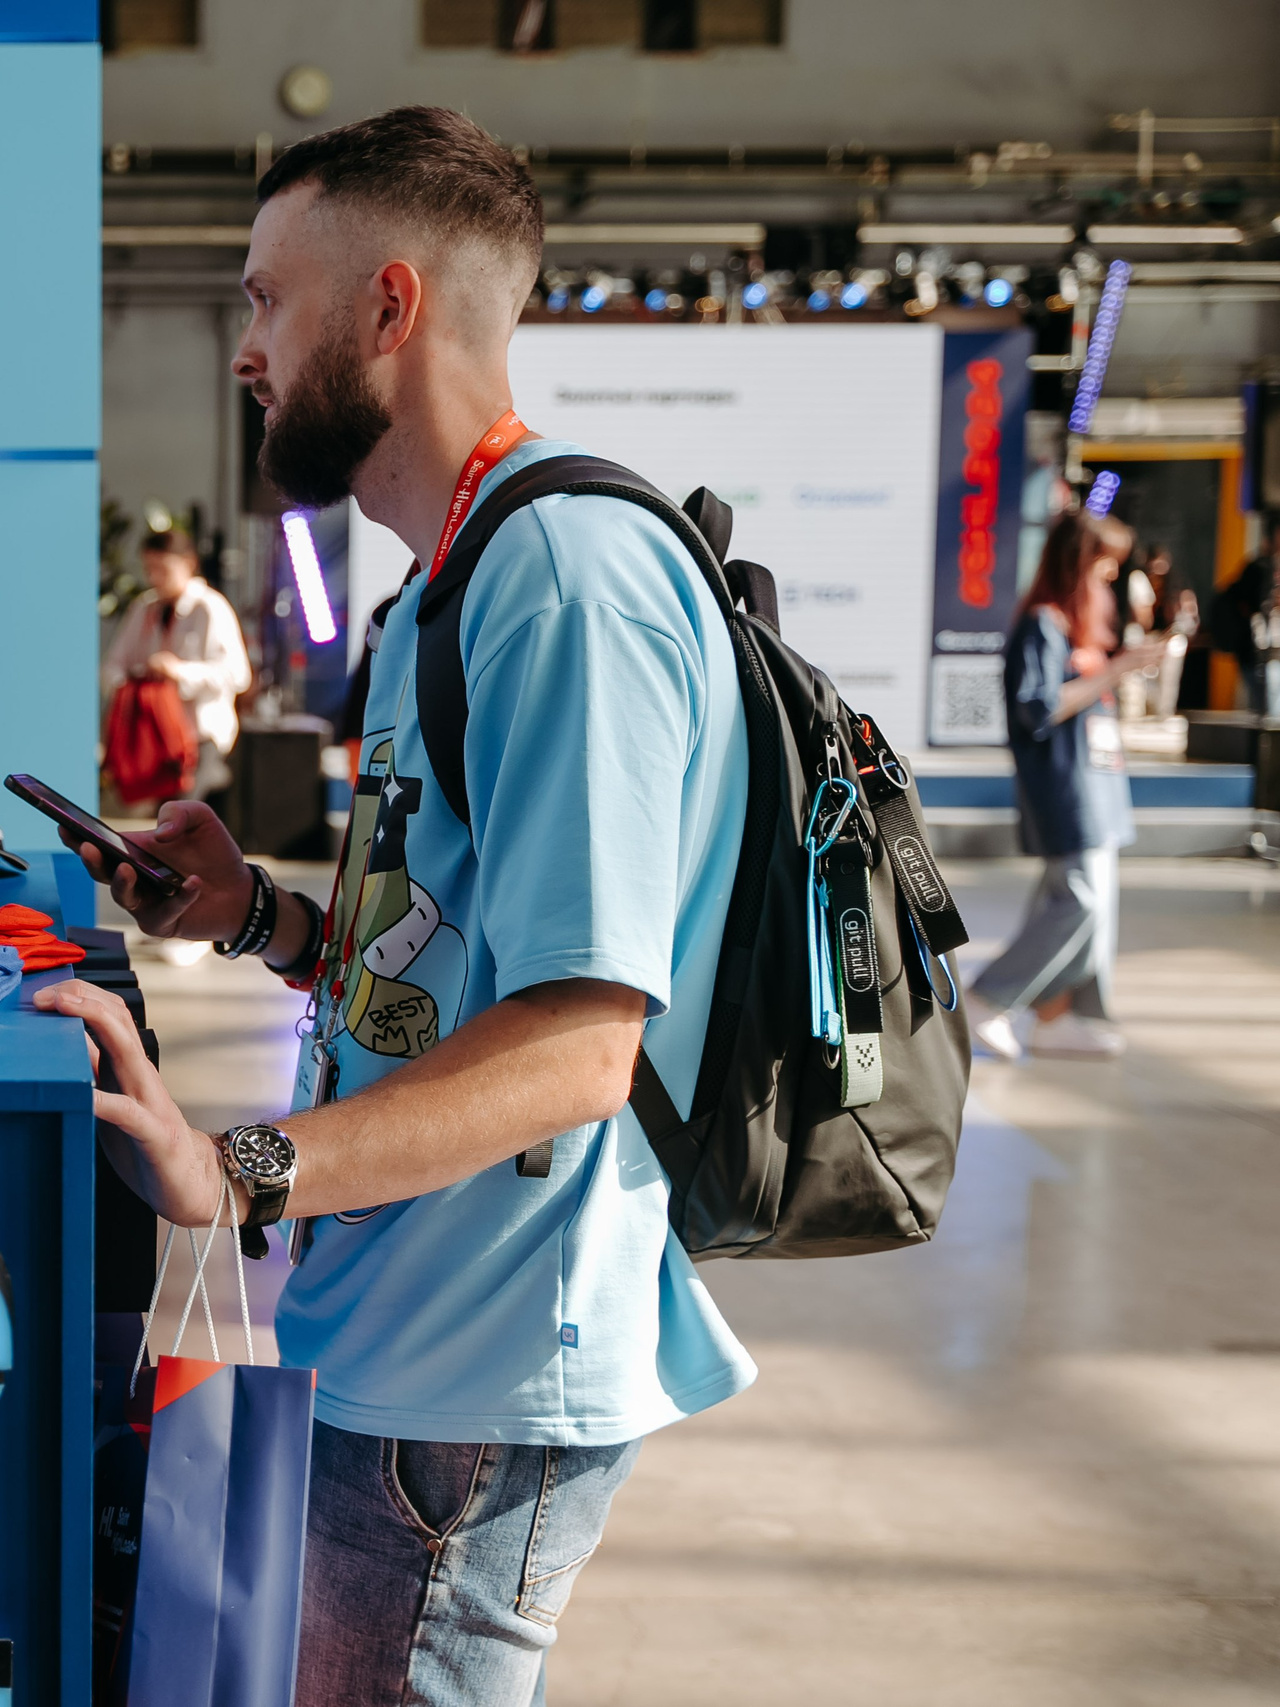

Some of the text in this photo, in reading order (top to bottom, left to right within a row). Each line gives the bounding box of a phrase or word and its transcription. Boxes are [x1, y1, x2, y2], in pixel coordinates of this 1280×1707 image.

[437, 459, 485, 561] Saint HighLoad++
[899, 847, 940, 904] git pull
[844, 919, 869, 981] git pull
[367, 995, 428, 1029] BEST
